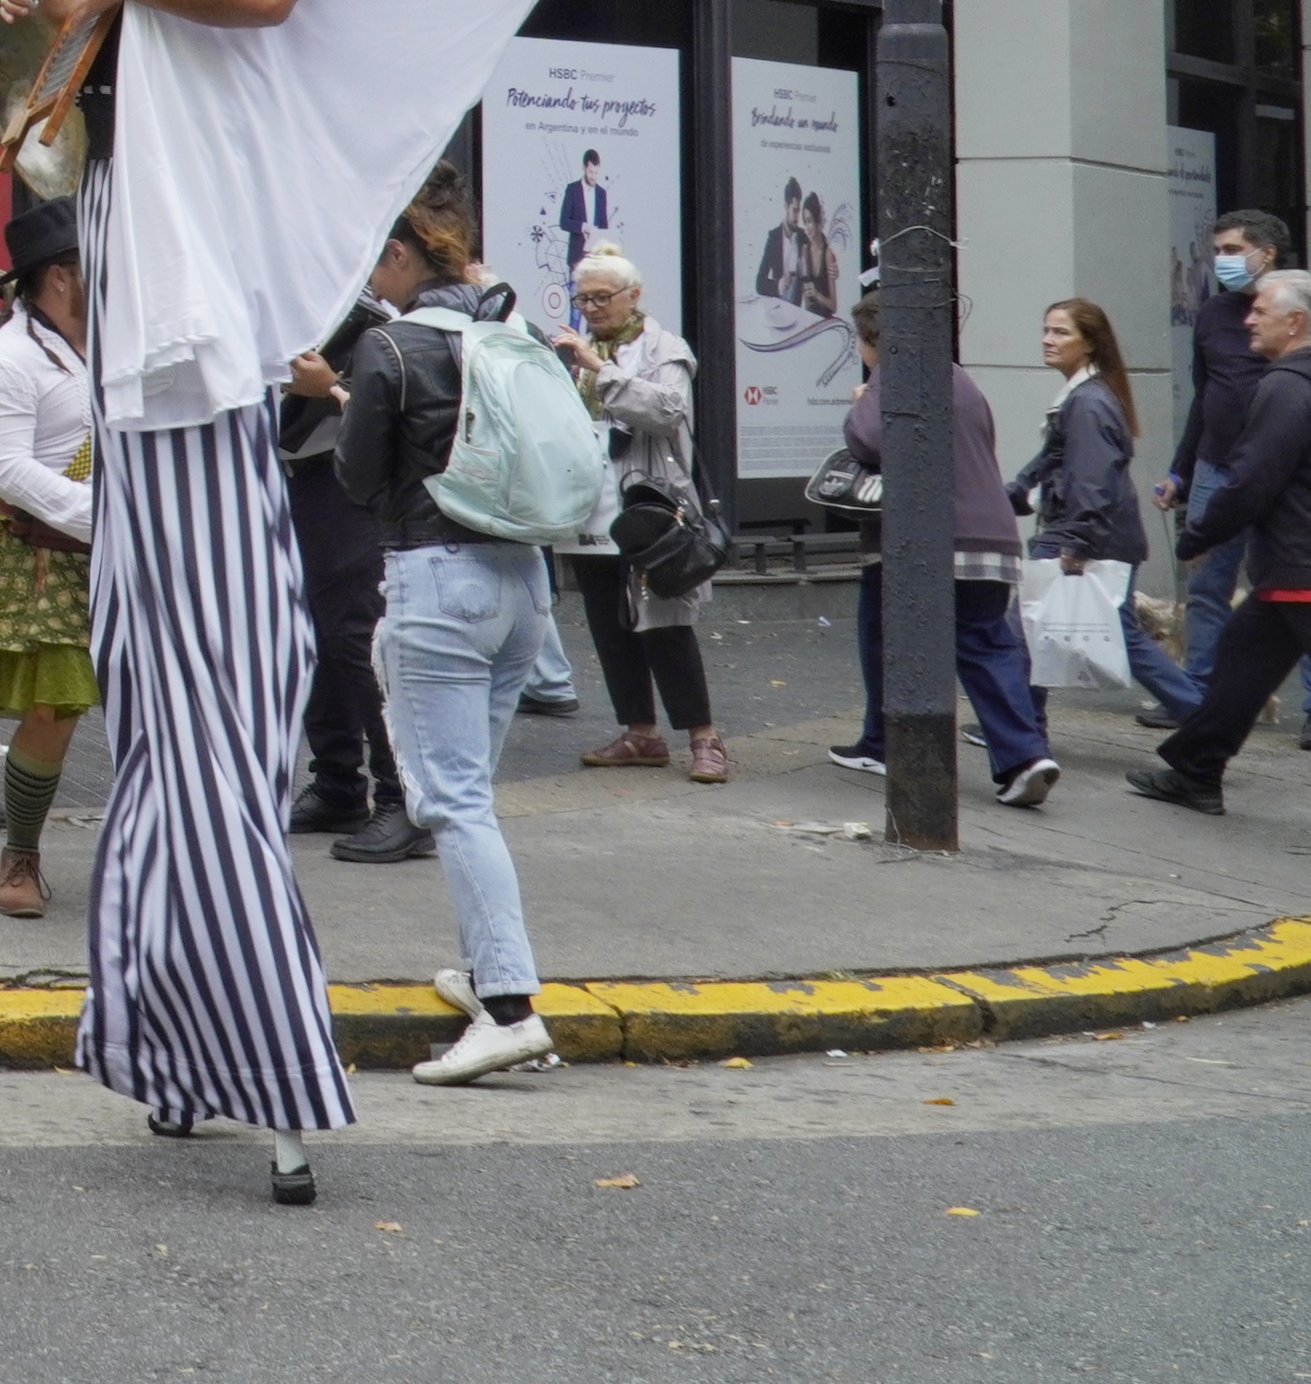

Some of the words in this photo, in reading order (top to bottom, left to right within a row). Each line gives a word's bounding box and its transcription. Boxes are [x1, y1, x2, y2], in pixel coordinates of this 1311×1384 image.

[549, 68, 578, 80] HSBC
[580, 69, 615, 83] Premier
[774, 88, 793, 100] HSBC
[506, 87, 578, 111] Potenciando
[580, 94, 601, 114] tus
[601, 98, 656, 128] proyectos
[751, 105, 795, 128] Brindando
[811, 111, 838, 133] mundo
[525, 122, 536, 130] en
[538, 122, 578, 133] Argentina
[587, 125, 598, 134] en
[600, 125, 608, 134] el
[610, 126, 639, 137] mundo
